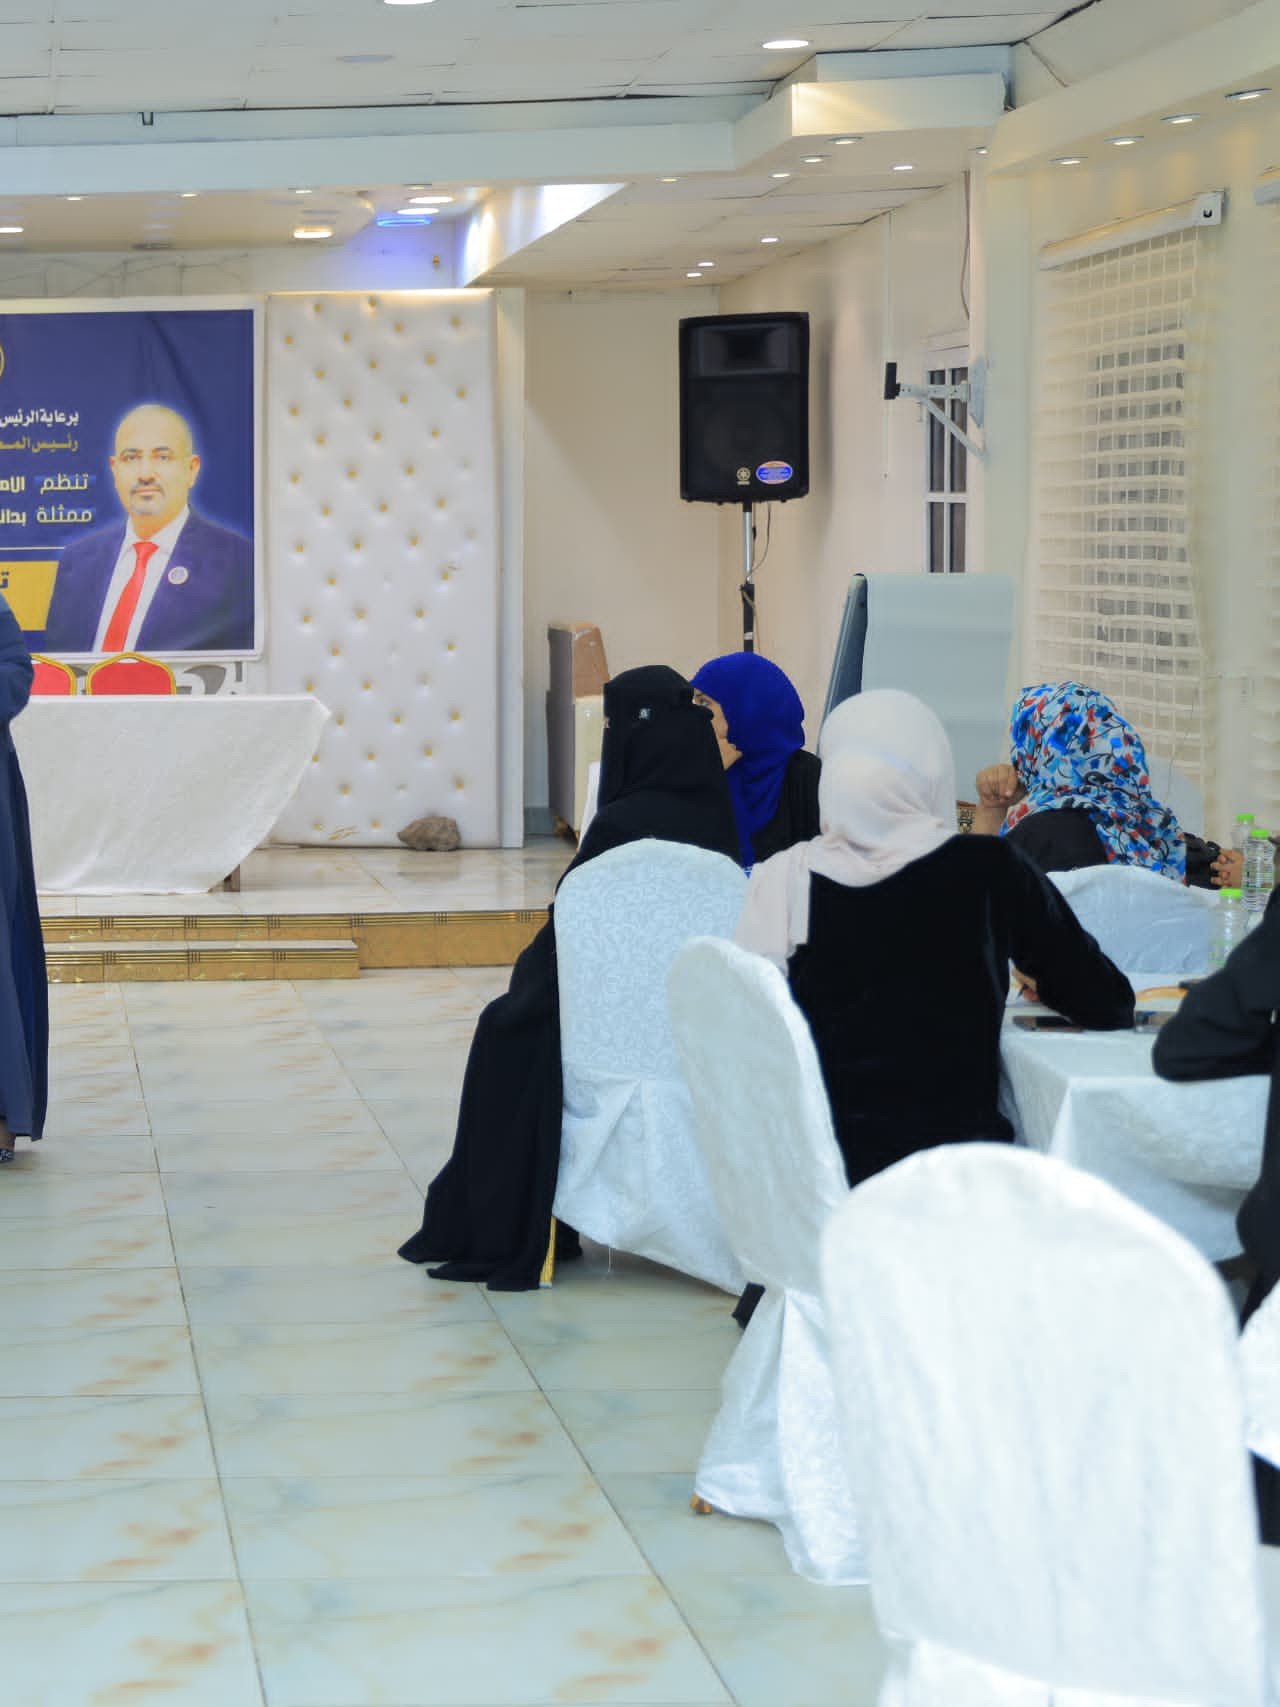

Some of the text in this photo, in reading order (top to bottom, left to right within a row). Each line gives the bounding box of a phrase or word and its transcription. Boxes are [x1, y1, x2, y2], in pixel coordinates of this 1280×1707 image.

[0, 408, 39, 428] الرئيس
[40, 409, 79, 427] برعاية
[32, 432, 78, 454] رئيس
[40, 472, 89, 496] تنظم
[36, 504, 93, 523] ممثلة
